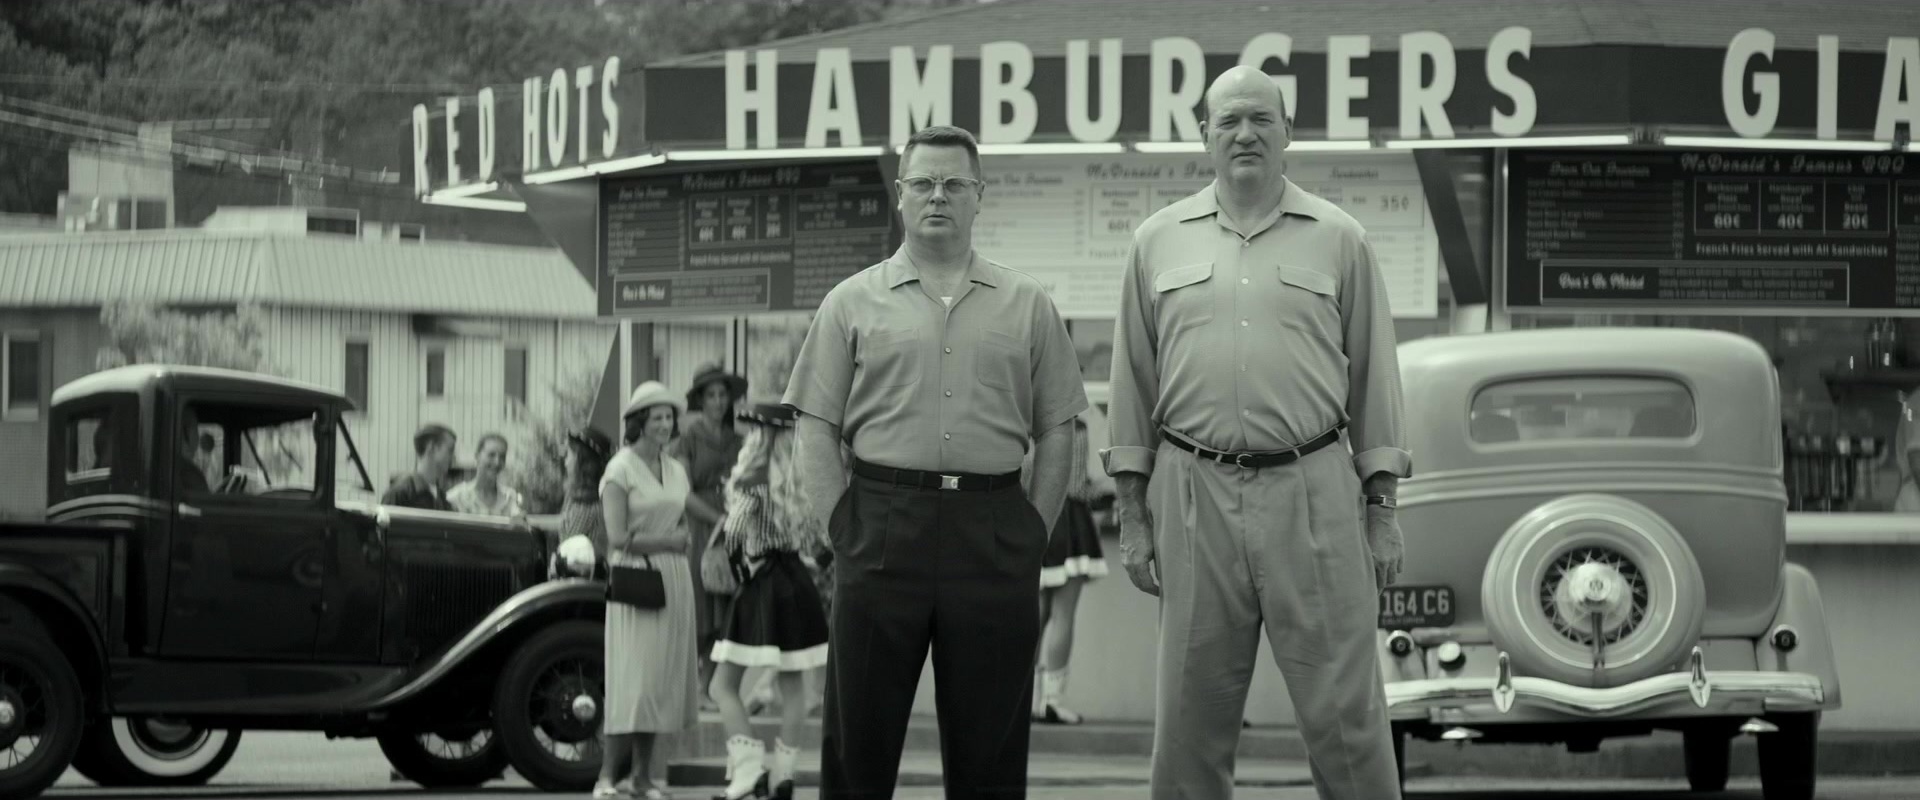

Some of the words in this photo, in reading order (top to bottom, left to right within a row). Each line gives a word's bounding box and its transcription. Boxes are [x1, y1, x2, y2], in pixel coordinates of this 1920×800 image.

[725, 26, 1537, 149] HAMBURGERS
[413, 86, 495, 199] RED
[523, 56, 620, 173] HOTS
[1713, 213, 1740, 229] 60¢
[1777, 213, 1804, 230] 40¢
[1696, 242, 1729, 257] French
[1731, 242, 1755, 257] Fries
[1757, 242, 1790, 257] Served
[1791, 243, 1814, 257] with
[1816, 243, 1830, 257] All
[1832, 243, 1888, 258] Sandwiches
[1382, 590, 1417, 616] 164
[1423, 588, 1450, 615] C6
